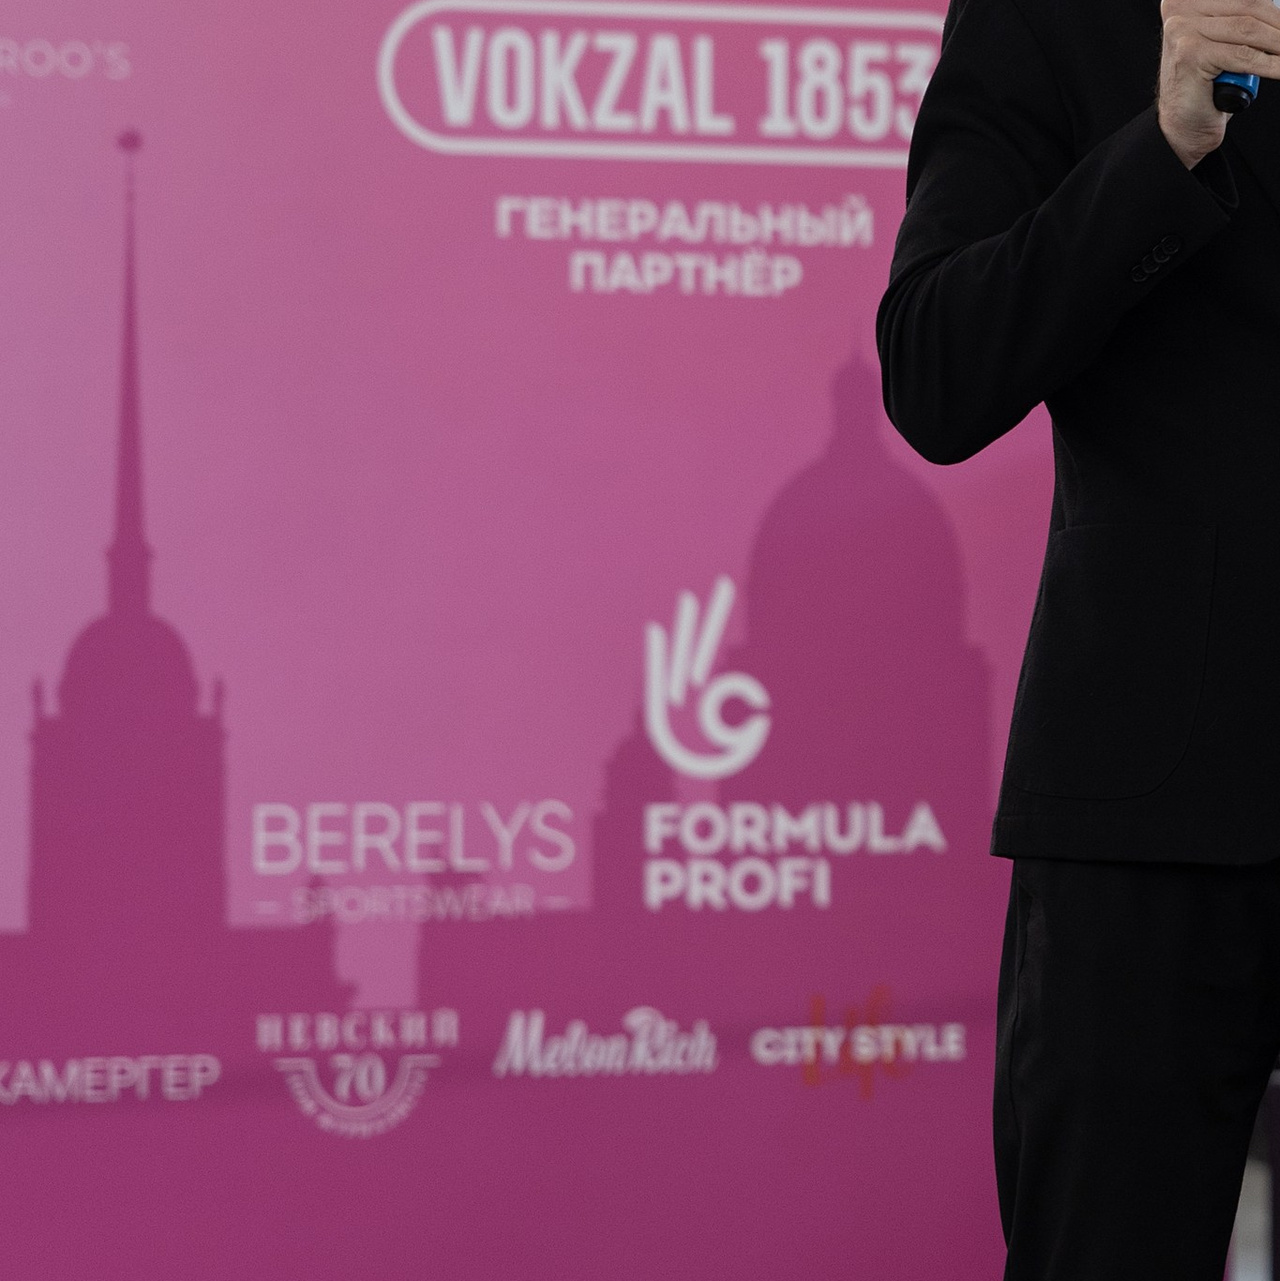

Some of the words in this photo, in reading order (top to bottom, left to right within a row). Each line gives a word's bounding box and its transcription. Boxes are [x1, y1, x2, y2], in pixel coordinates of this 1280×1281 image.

[434, 26, 735, 135] VOKZAL
[760, 37, 936, 143] 1853
[496, 194, 874, 249] ГЕНЕРАЛЬНЫЙ
[568, 247, 803, 297] ПАРТНЁР
[252, 799, 576, 874] BERELYS
[643, 801, 947, 855] FORMULA
[643, 857, 833, 910] PROFI
[752, 1026, 846, 1066] CITY
[852, 1022, 967, 1062] STYLE
[330, 1053, 387, 1102] 70
